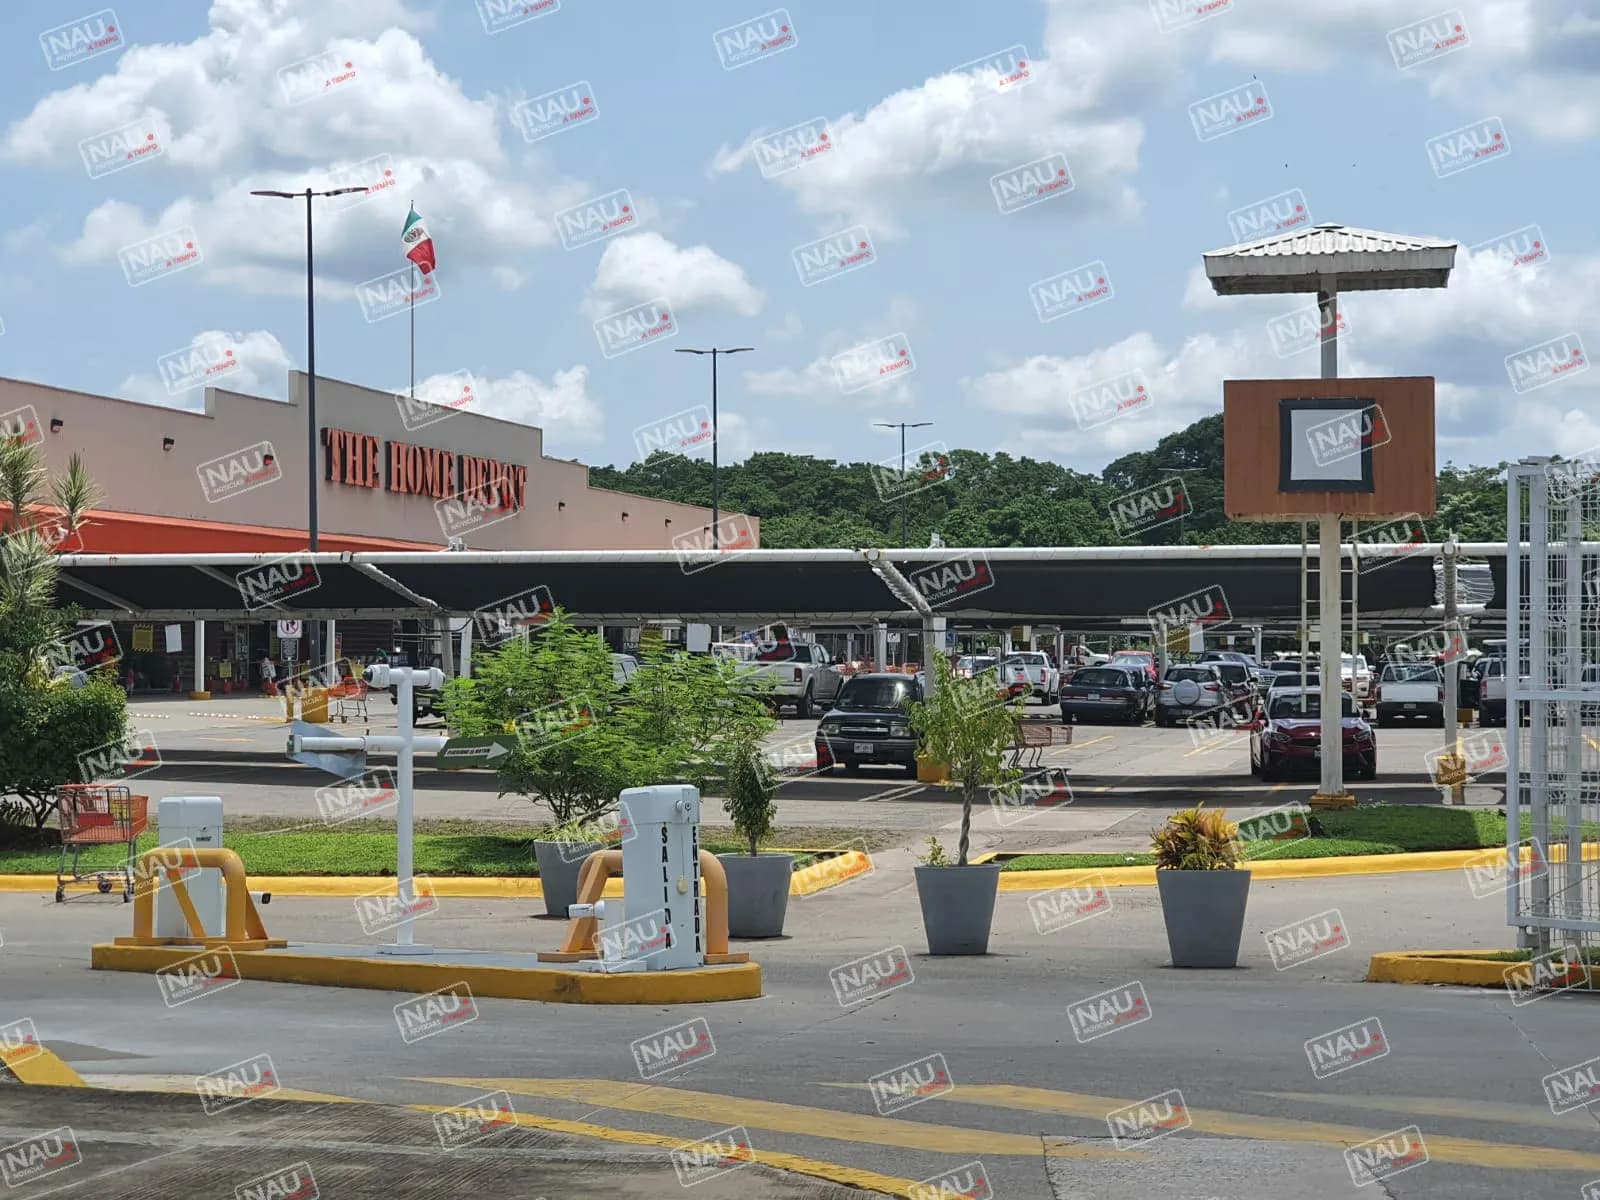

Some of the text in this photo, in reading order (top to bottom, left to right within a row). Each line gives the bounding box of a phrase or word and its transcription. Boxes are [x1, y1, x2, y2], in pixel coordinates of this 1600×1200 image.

[322, 427, 528, 510] THE HOME DEPOT
[661, 826, 672, 950] SALIDA
[692, 826, 702, 953] ENTRADA
